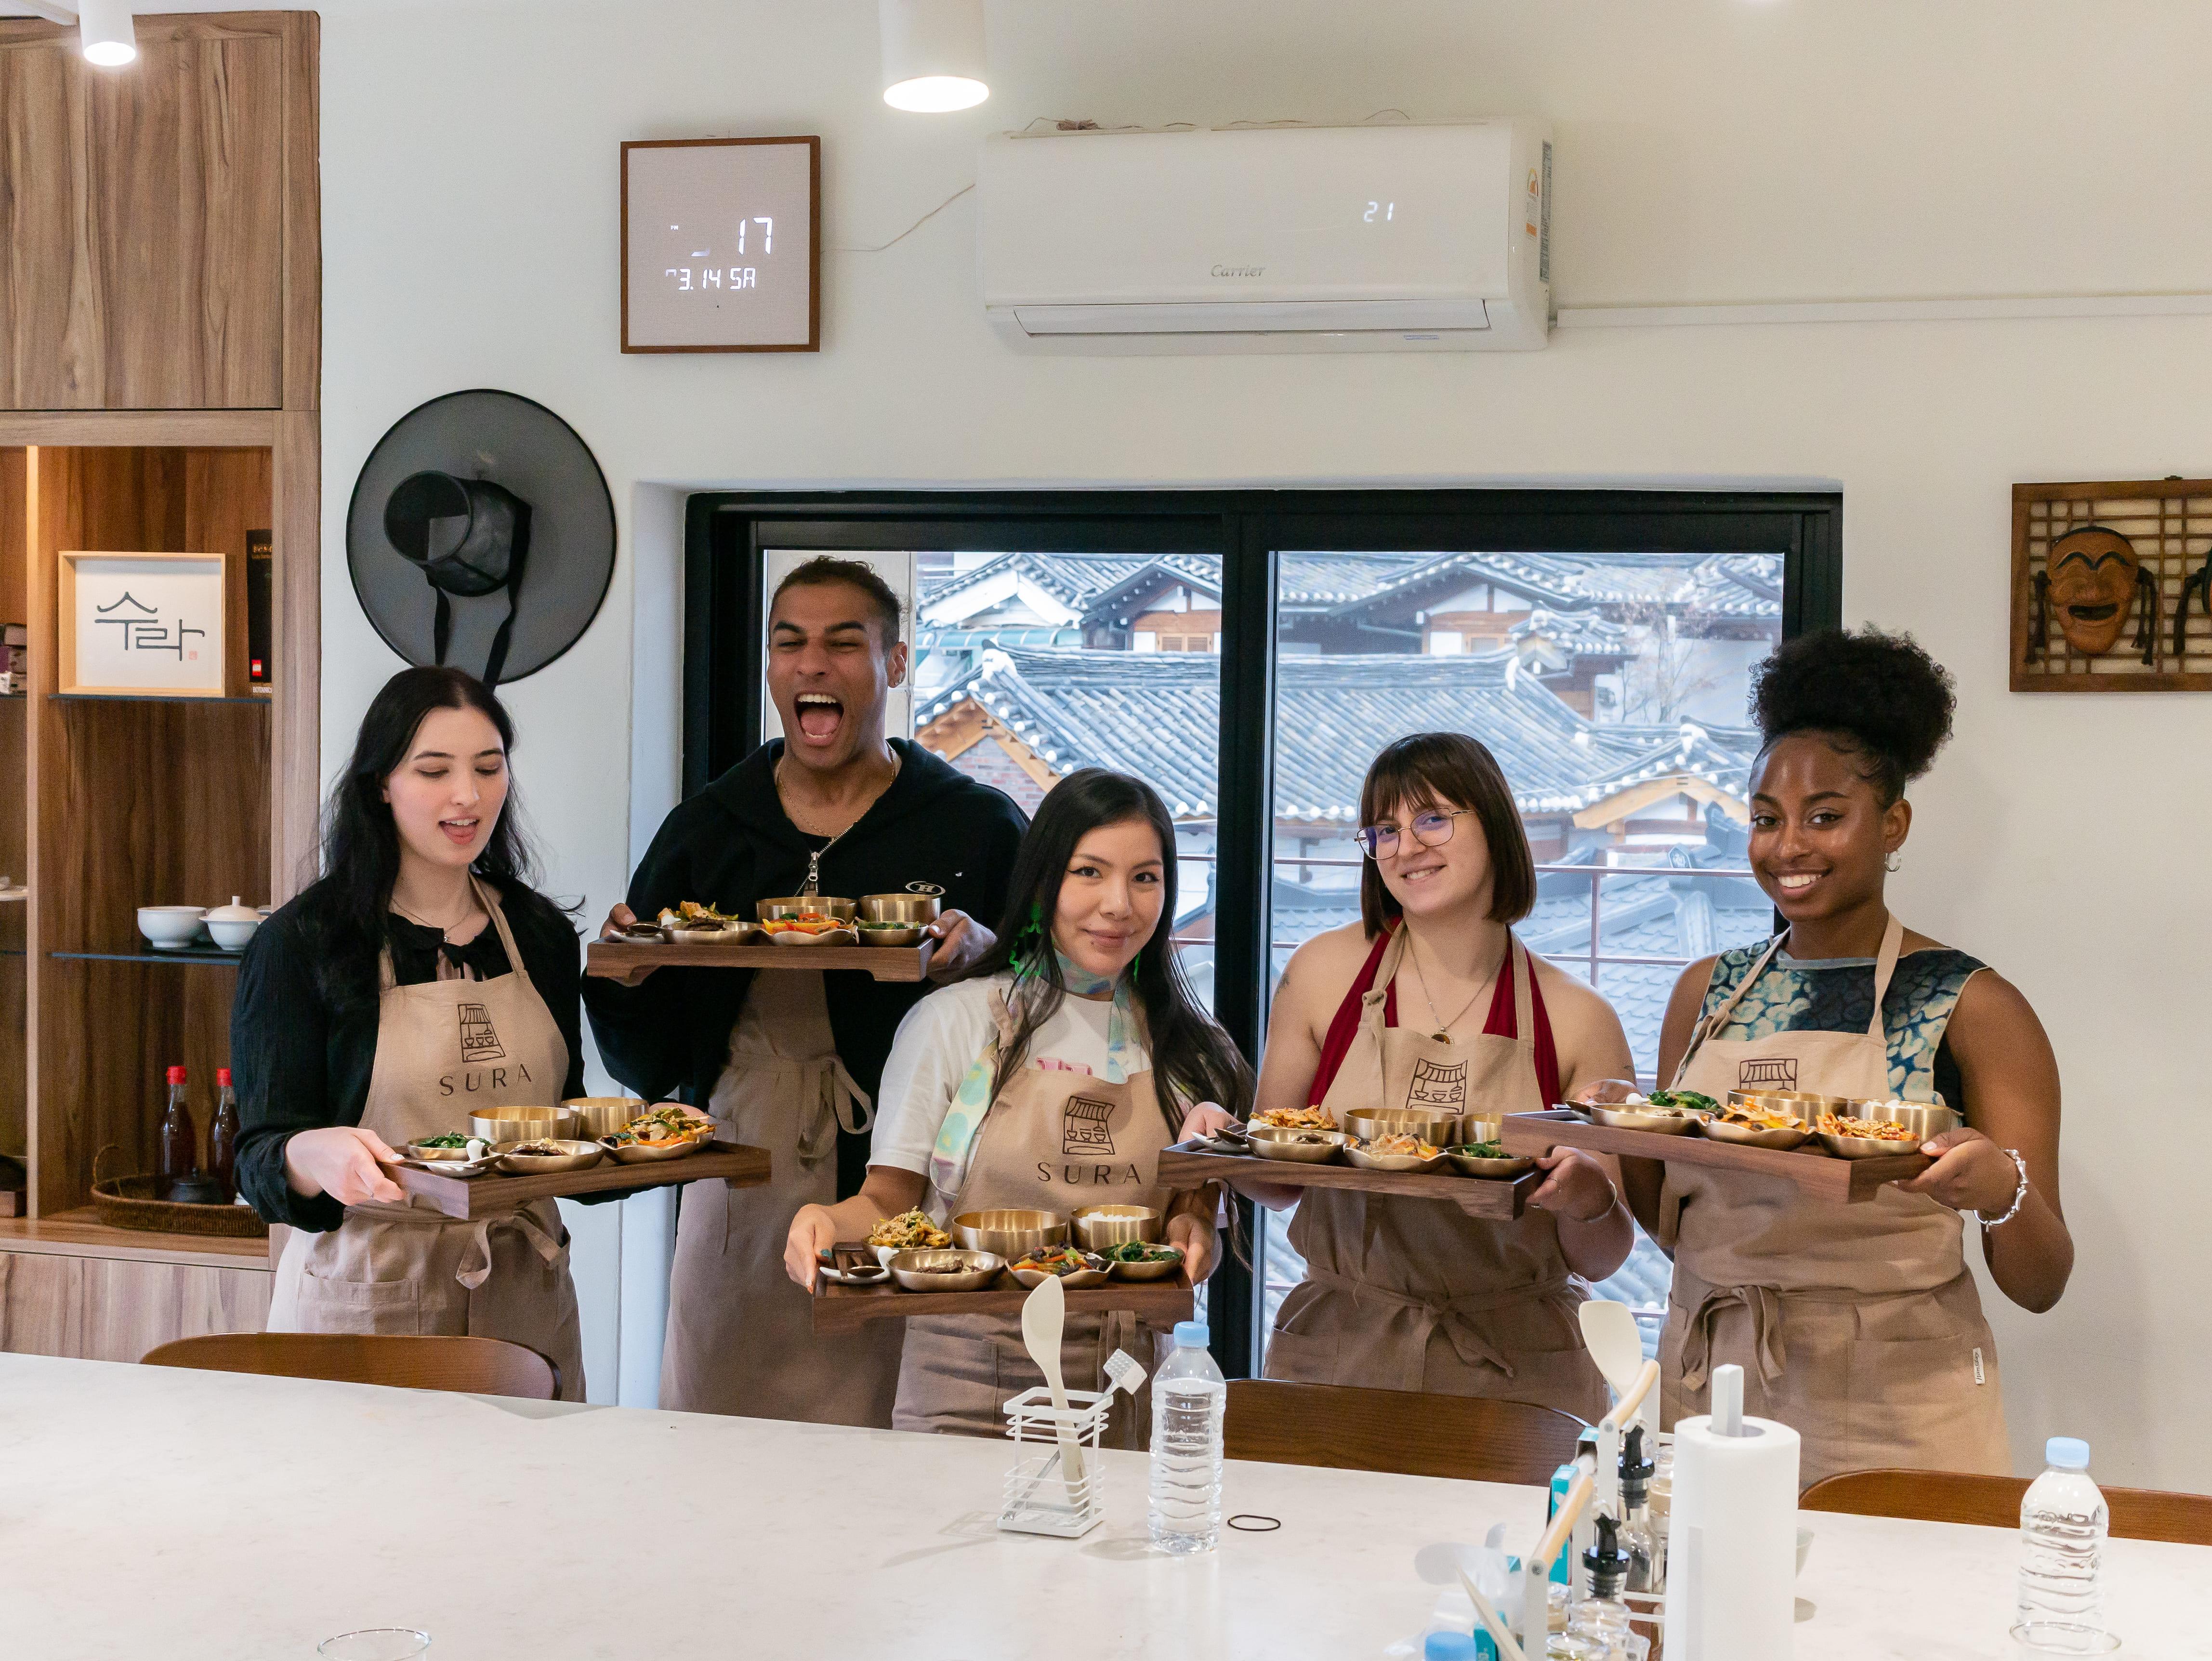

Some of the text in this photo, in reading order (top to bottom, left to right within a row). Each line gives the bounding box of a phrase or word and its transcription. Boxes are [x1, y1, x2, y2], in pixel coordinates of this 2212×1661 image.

[1363, 201, 1394, 222] 21
[1210, 264, 1265, 277] Carrier
[94, 591, 206, 662] 수라
[439, 1063, 532, 1096] SURA
[1037, 1161, 1142, 1185] SURA
